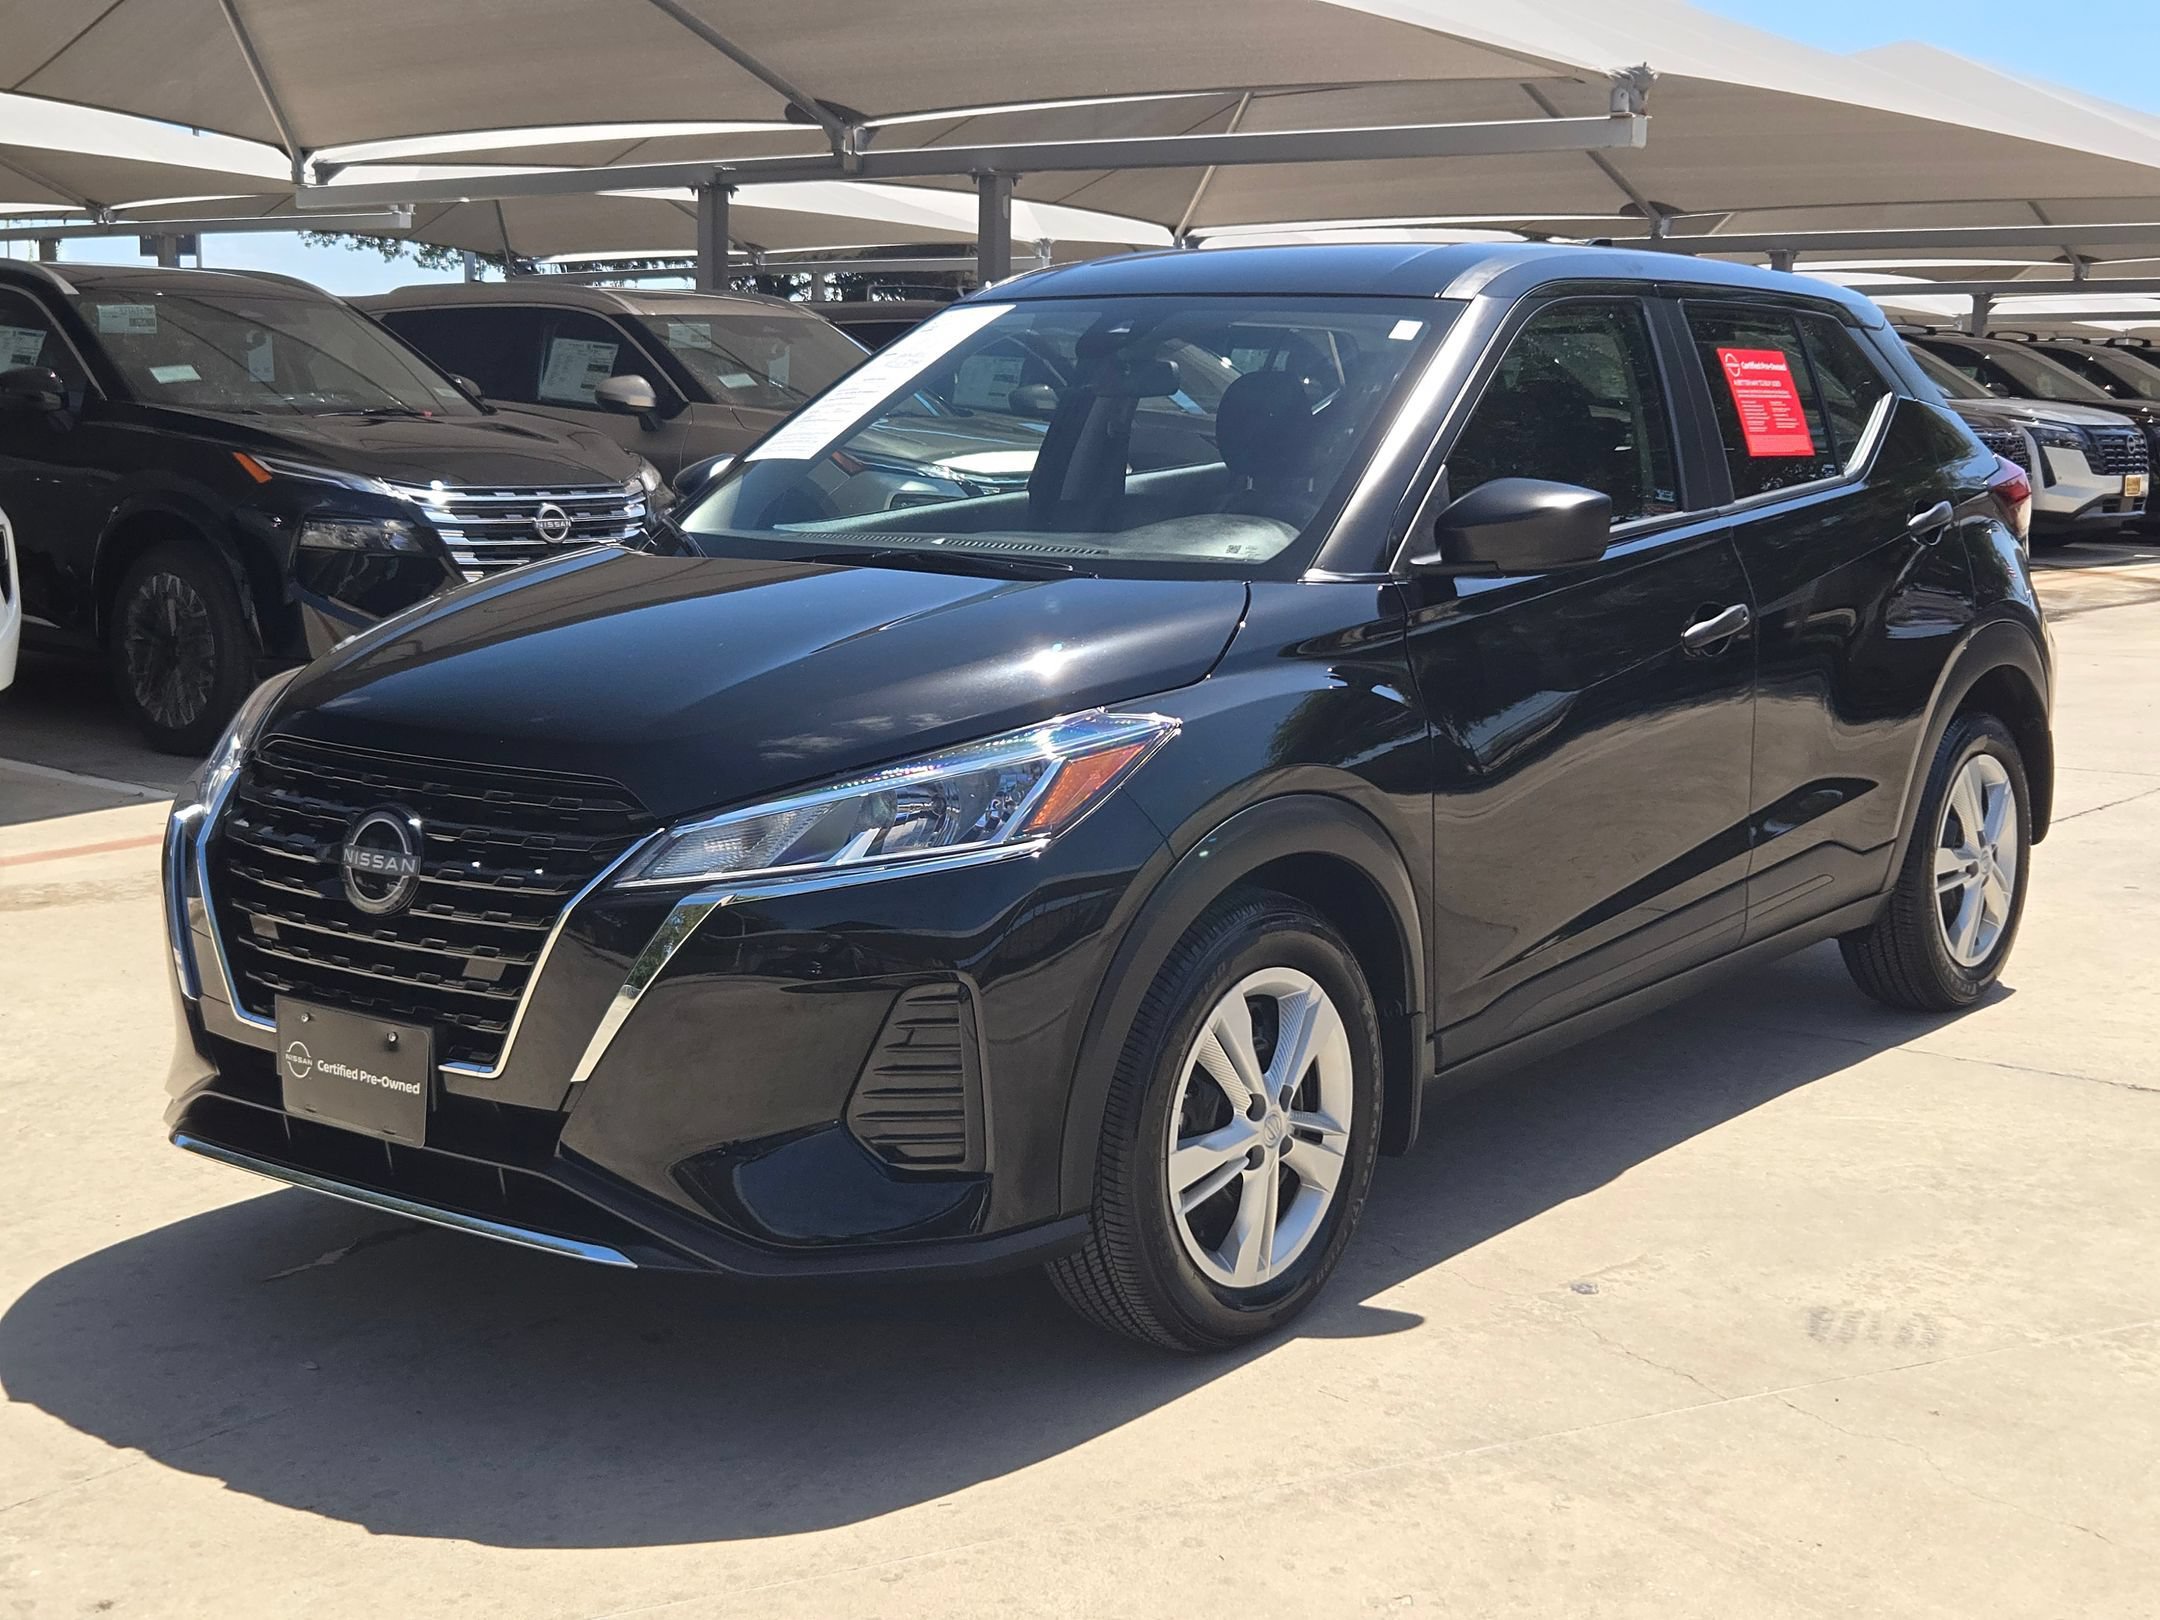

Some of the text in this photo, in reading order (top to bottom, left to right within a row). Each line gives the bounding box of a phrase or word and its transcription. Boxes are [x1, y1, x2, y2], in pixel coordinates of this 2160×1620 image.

[344, 848, 415, 872] NISSAN
[286, 1053, 312, 1066] NISSAN
[317, 1060, 420, 1095] Certified Pre-Owned
